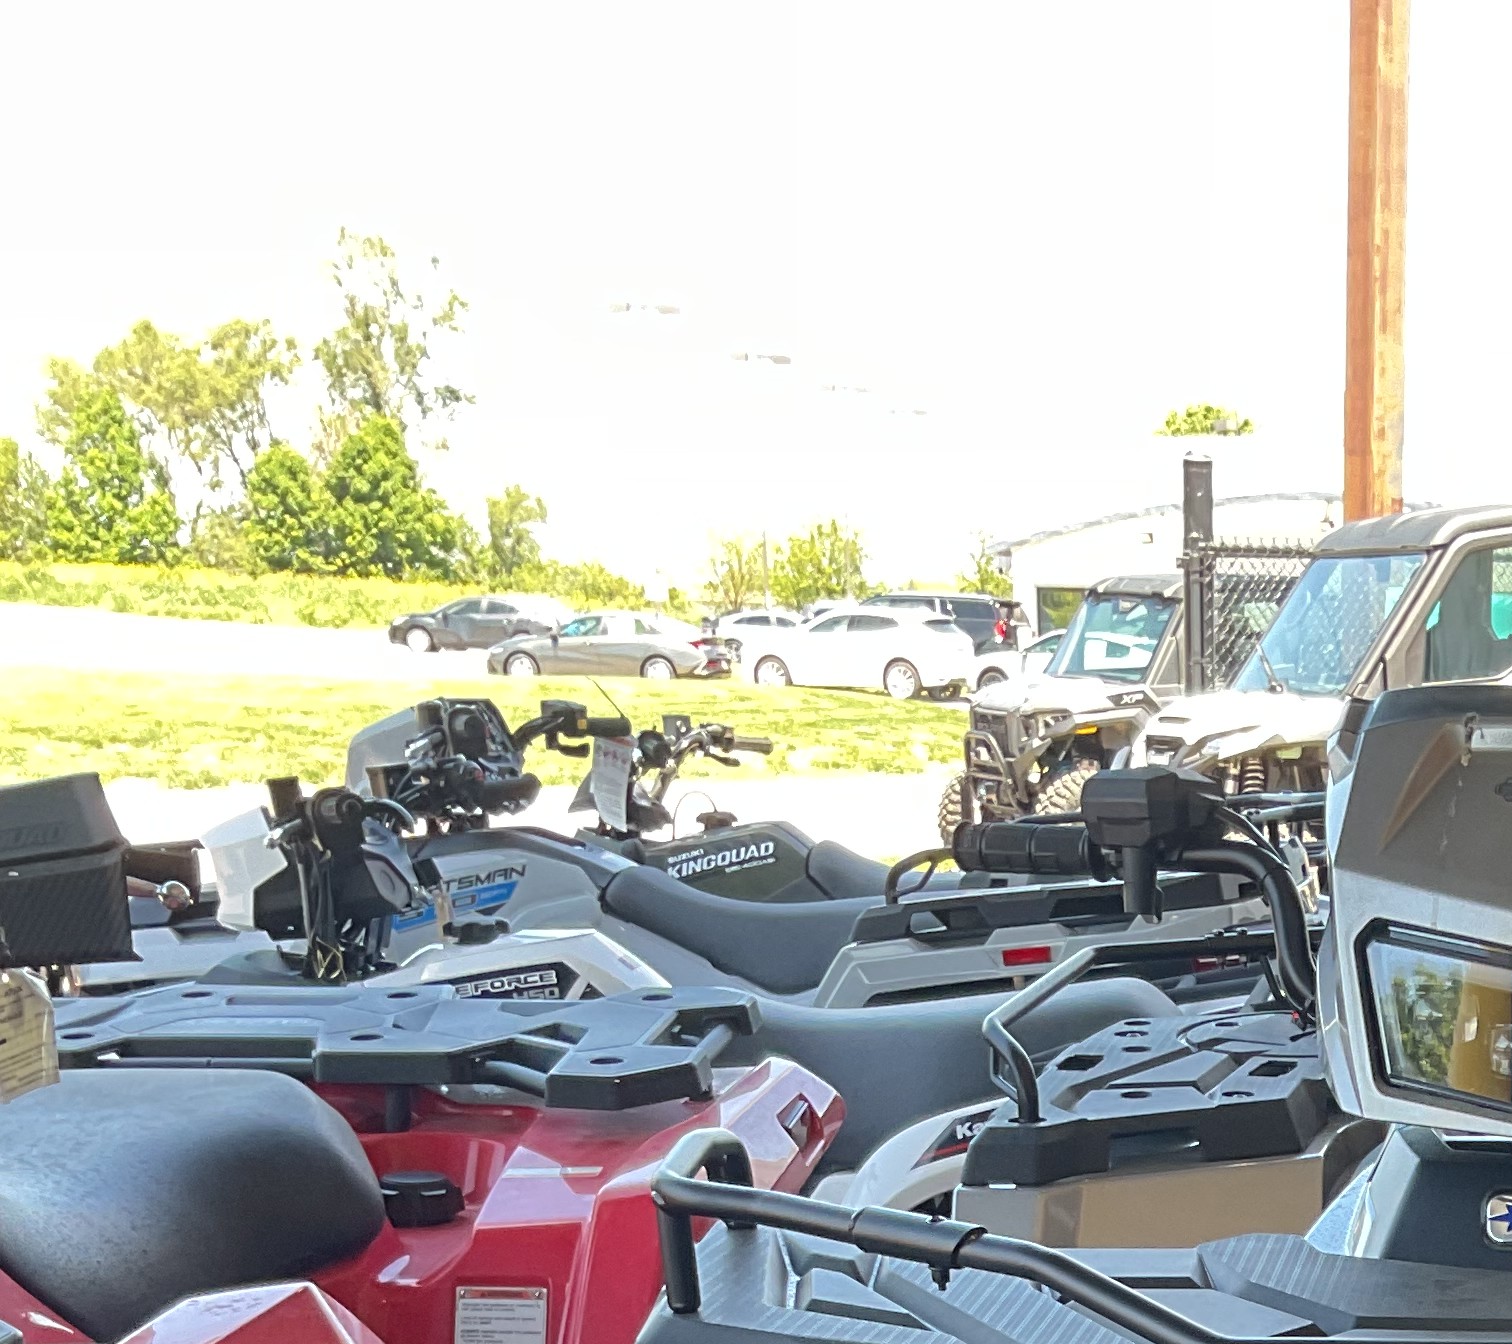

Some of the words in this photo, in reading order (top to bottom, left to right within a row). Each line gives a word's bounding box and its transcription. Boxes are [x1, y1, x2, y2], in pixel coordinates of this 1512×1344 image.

[1120, 693, 1144, 704] XP
[666, 841, 775, 879] KINGQUAD
[667, 848, 704, 864] SUZUKI
[443, 864, 527, 892] TSMAN
